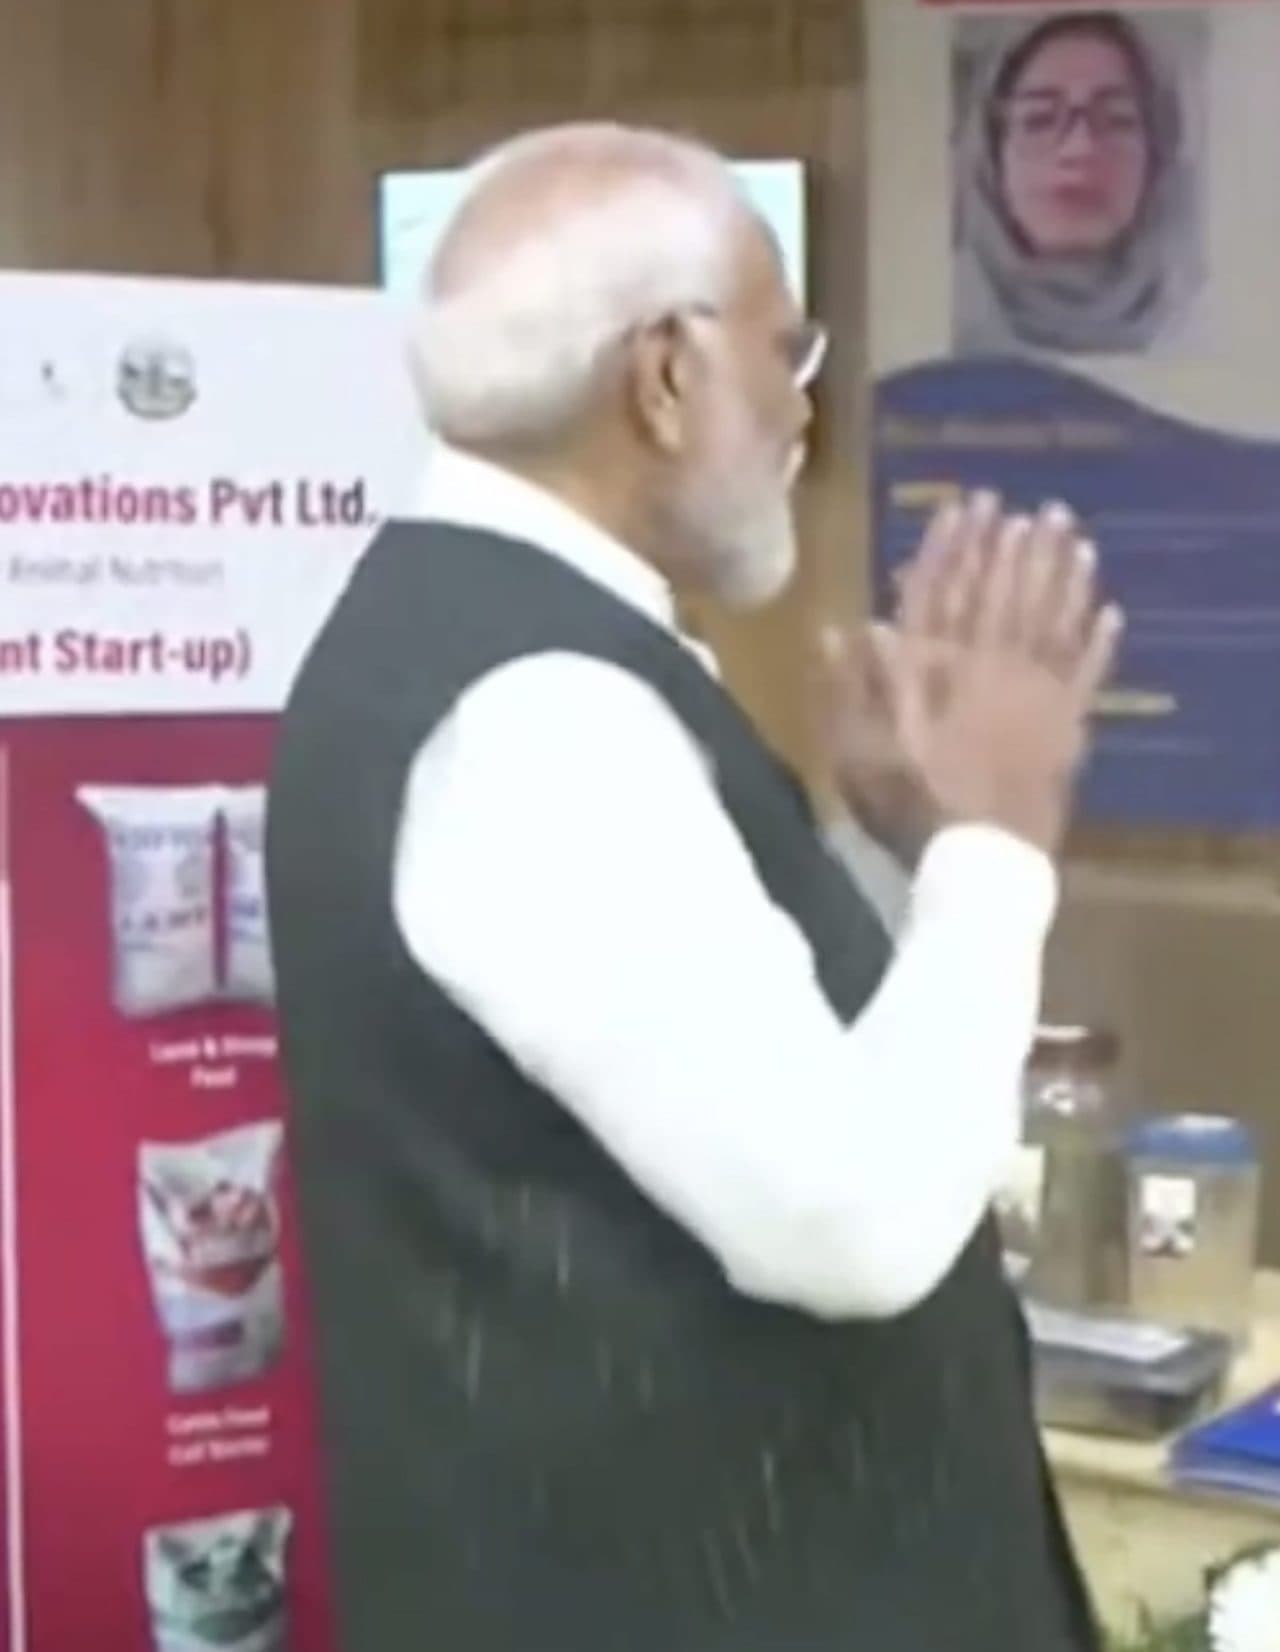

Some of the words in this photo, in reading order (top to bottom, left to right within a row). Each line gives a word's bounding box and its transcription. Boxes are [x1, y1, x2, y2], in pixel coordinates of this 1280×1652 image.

[0, 473, 197, 525] ovations
[209, 477, 287, 526] Pvt
[299, 477, 378, 526] Ltd.
[54, 628, 251, 682] Start-up)
